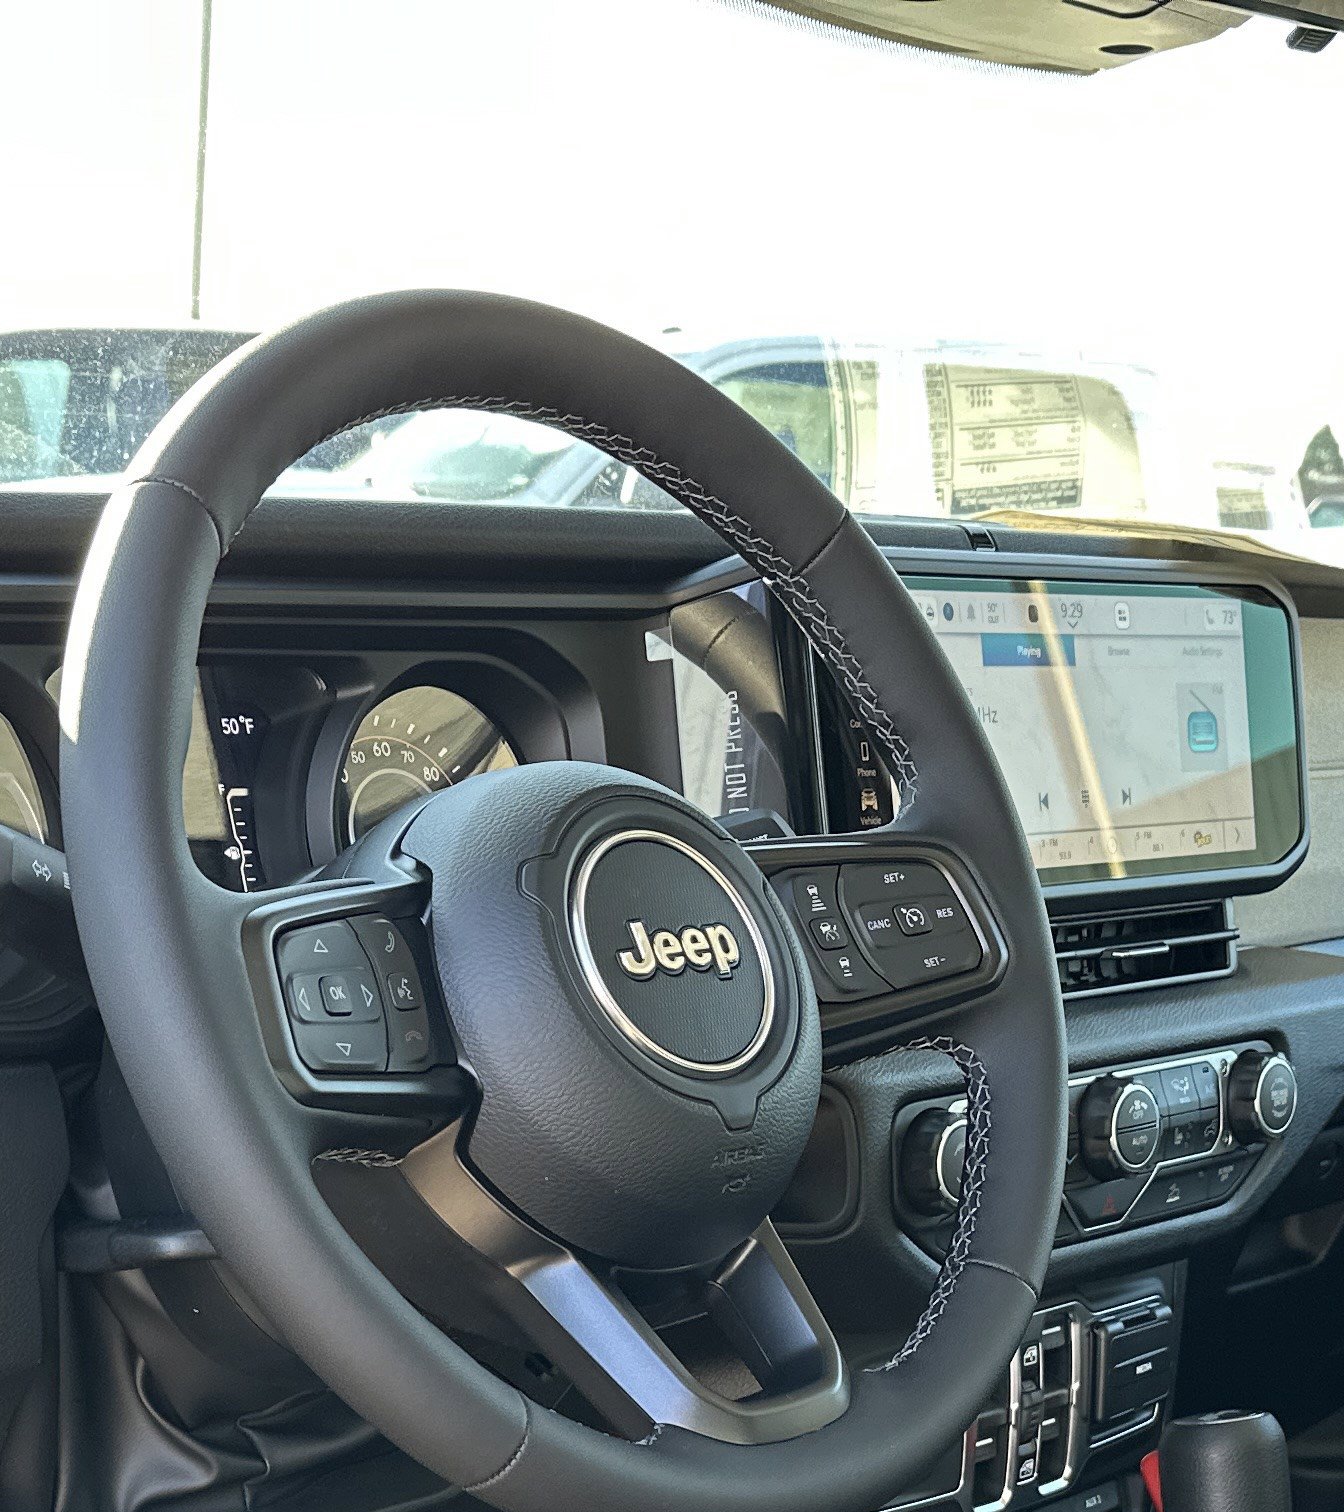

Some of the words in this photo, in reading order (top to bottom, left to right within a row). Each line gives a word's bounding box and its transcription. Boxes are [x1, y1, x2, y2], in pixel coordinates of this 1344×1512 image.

[372, 742, 391, 757] 60
[401, 750, 415, 764] 70
[423, 767, 440, 782] 80
[857, 767, 877, 777] Phone
[724, 763, 748, 799] NOT
[861, 815, 882, 826] Vehicle
[884, 873, 905, 884] SET+
[936, 908, 954, 919] RES
[867, 918, 891, 931] CANC
[617, 919, 739, 979] Jeep
[329, 986, 346, 1000] OK
